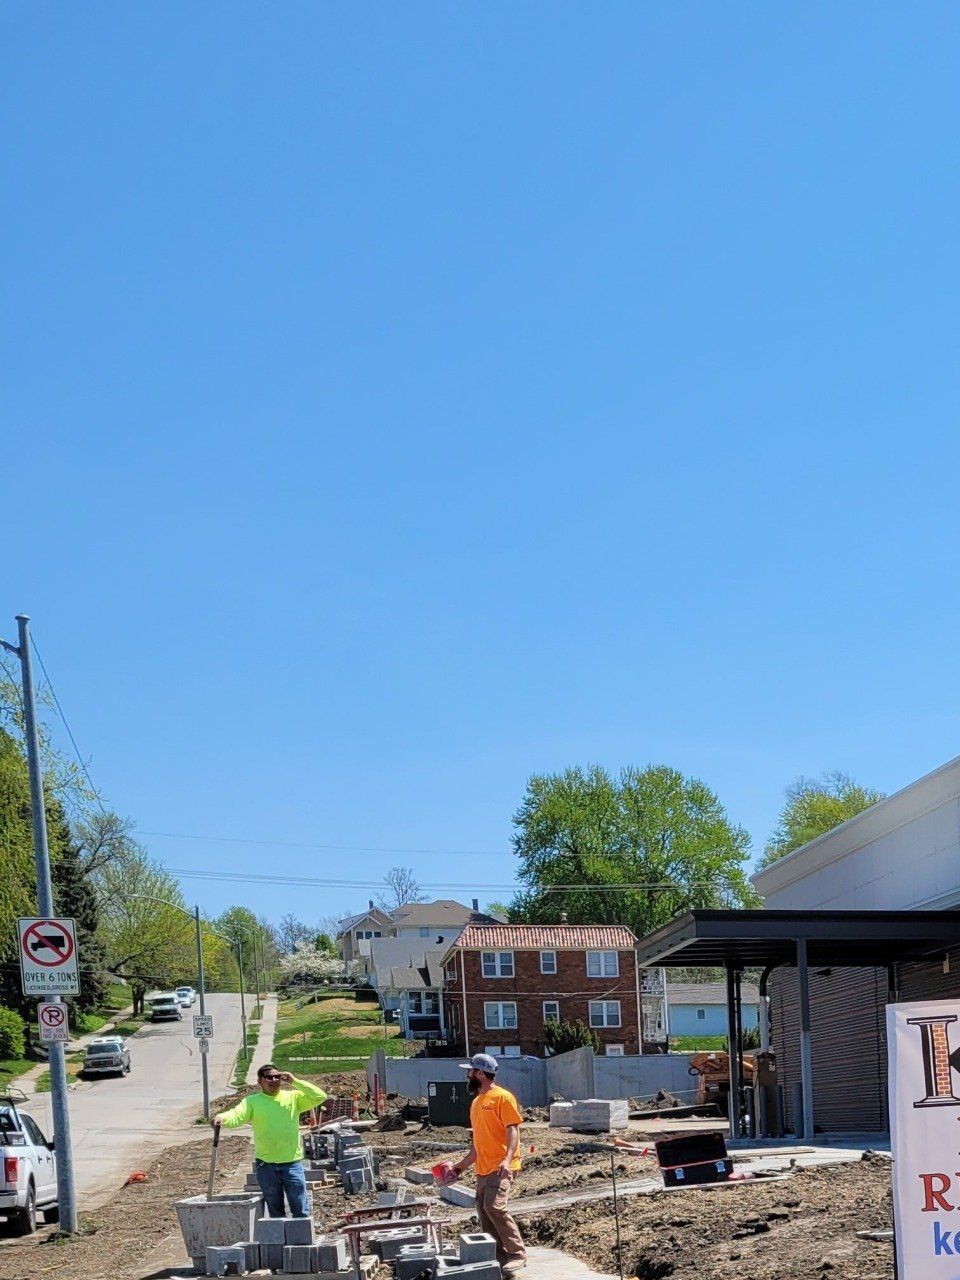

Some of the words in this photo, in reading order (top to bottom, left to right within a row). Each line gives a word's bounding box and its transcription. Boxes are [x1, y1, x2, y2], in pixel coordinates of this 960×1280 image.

[25, 972, 46, 982] OVER
[49, 972, 55, 982] 6
[57, 972, 77, 982] TONS
[196, 1027, 211, 1035] 25
